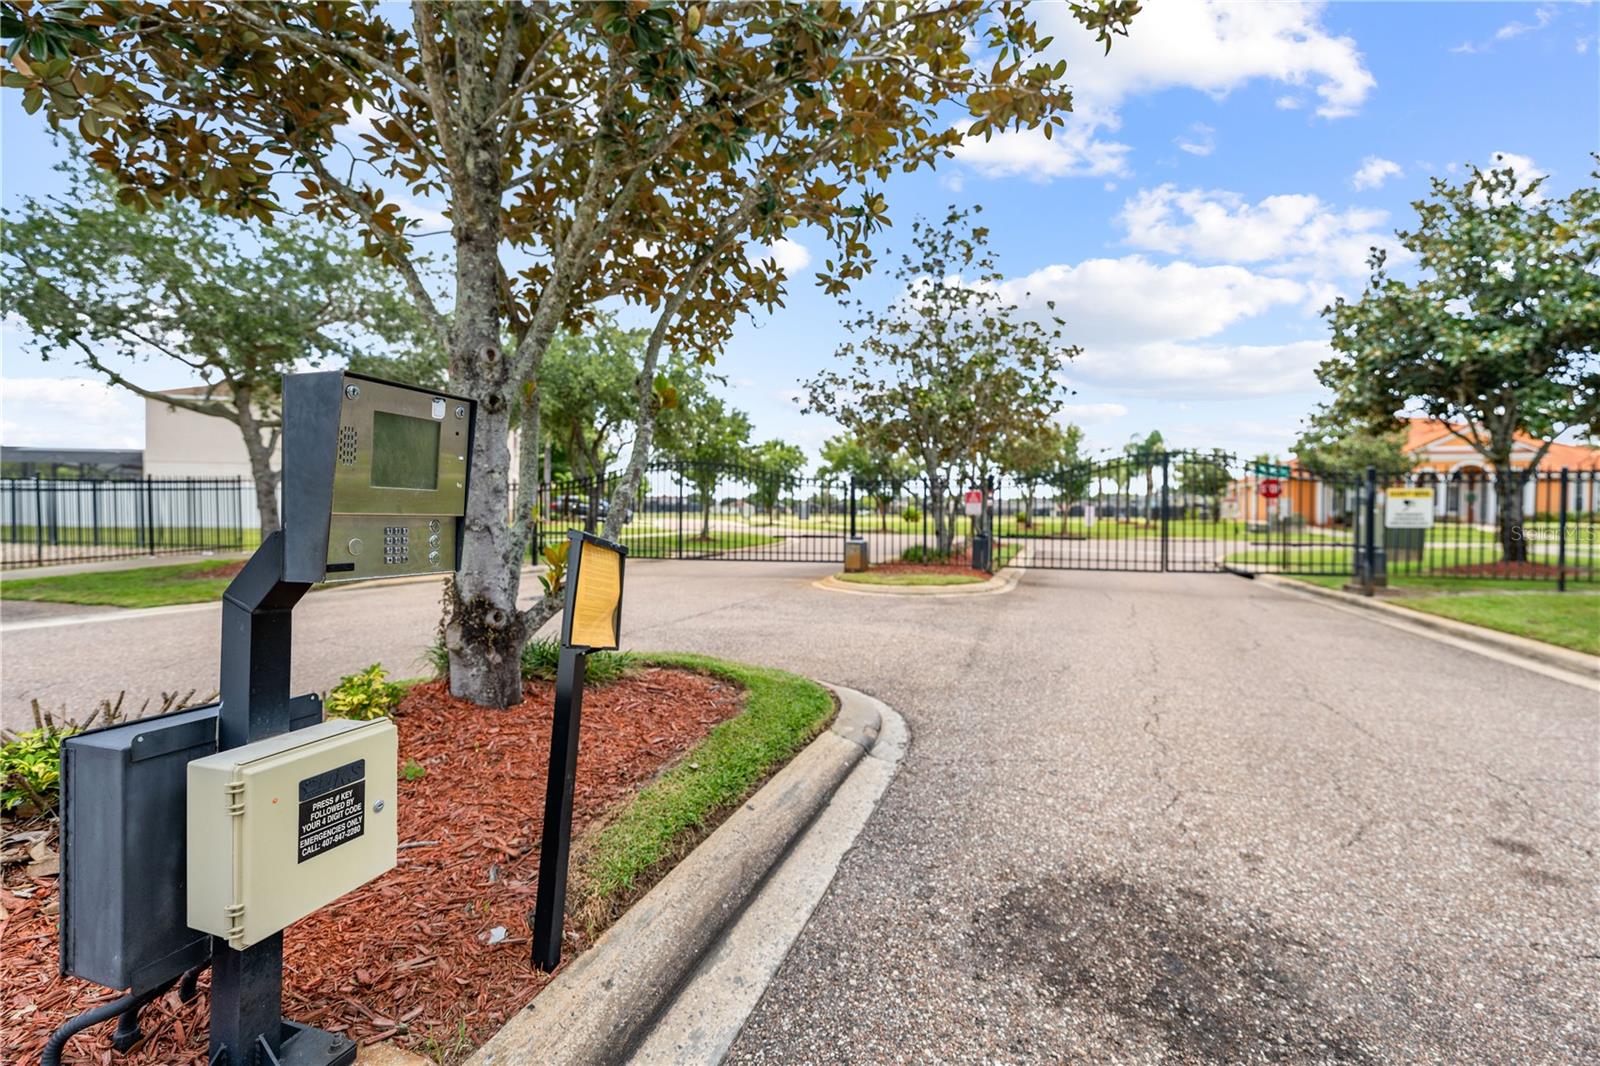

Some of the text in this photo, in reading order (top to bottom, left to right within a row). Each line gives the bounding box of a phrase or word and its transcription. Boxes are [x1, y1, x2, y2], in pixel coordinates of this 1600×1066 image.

[310, 797, 355, 821] FOLLOWED BY
[312, 797, 334, 811] PRESS
[340, 789, 353, 800] KEY
[302, 819, 321, 833] YOUR
[327, 810, 344, 823] DIGIT
[344, 802, 362, 816] CODE
[300, 815, 363, 848] EMERGENCIES ONLY
[302, 843, 321, 856] CALL:
